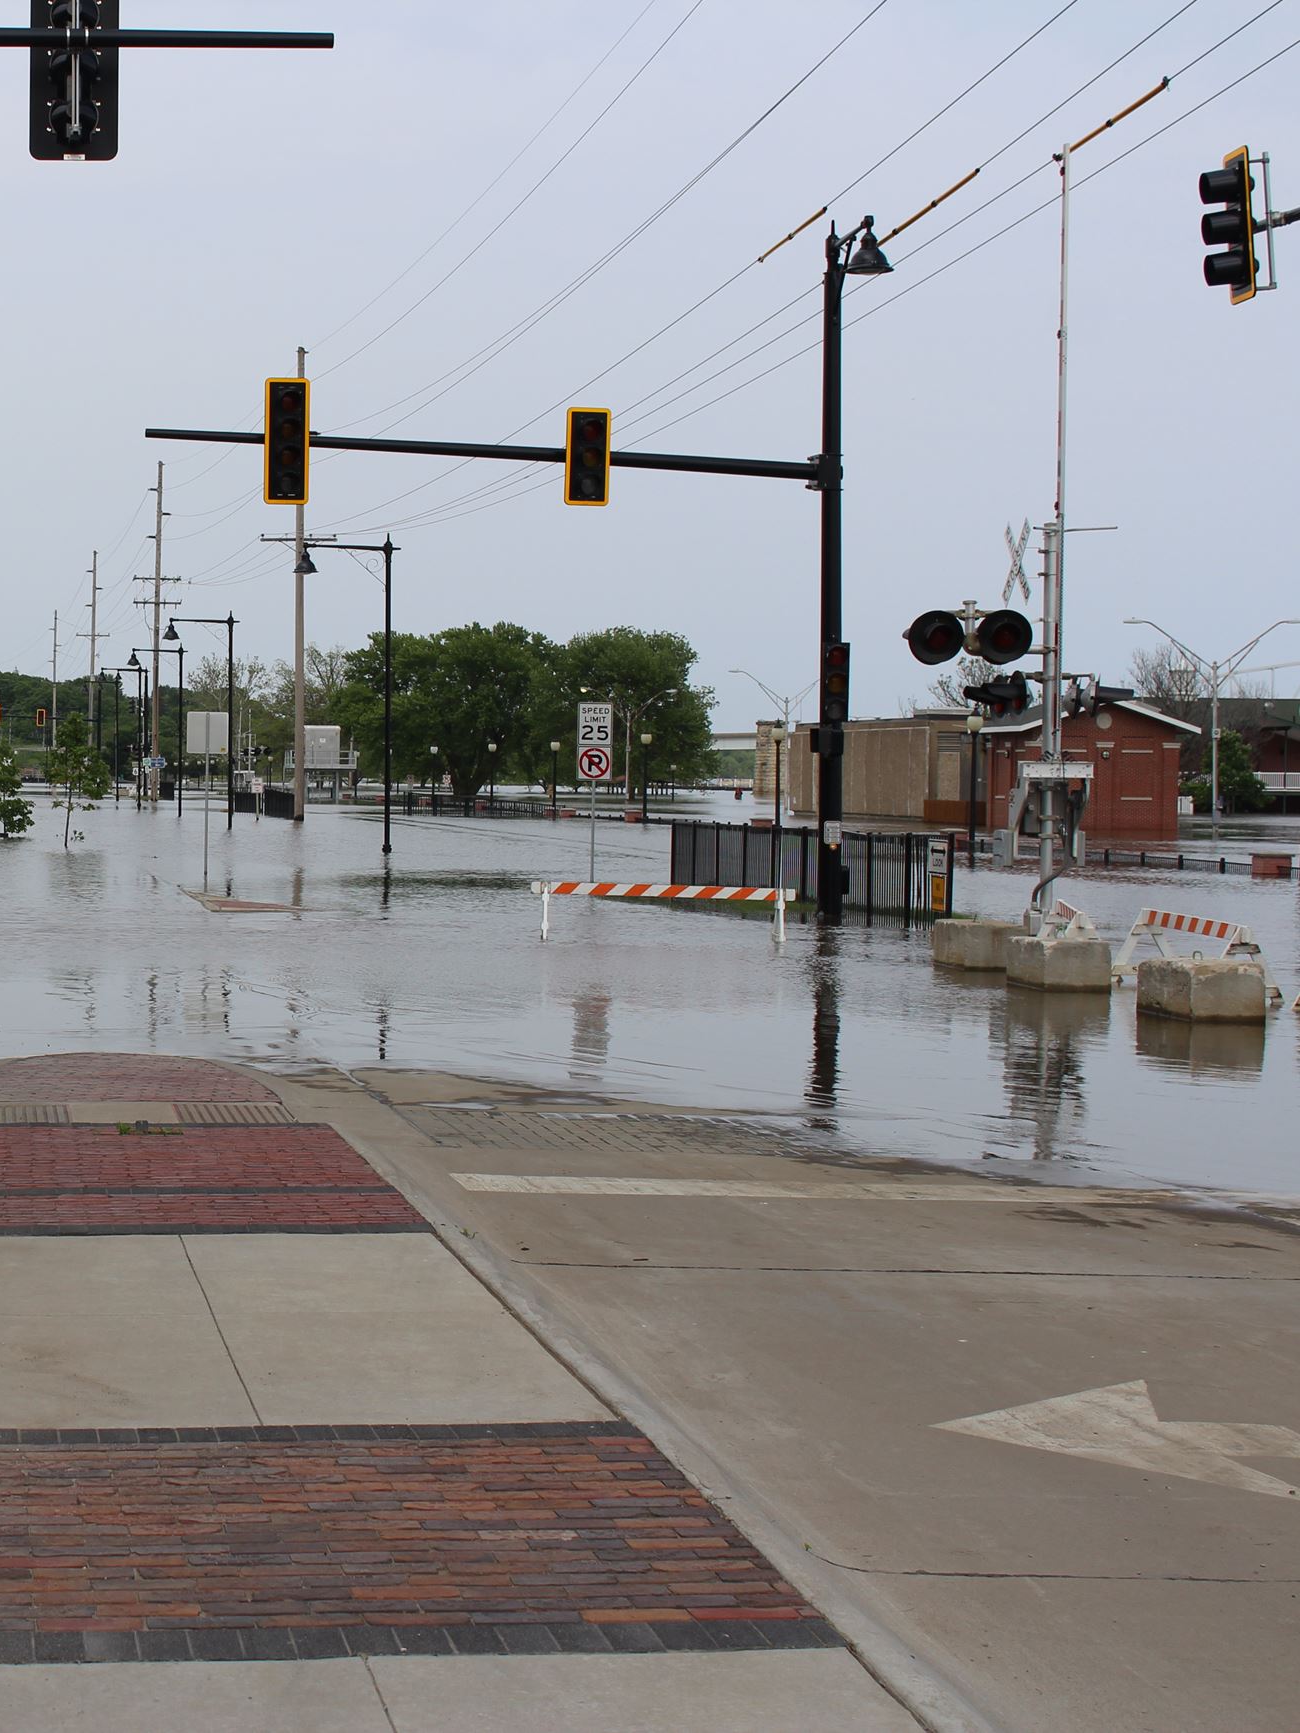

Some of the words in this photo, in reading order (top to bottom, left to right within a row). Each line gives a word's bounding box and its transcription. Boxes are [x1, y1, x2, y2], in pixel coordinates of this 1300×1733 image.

[1003, 518, 1030, 601] CROSSING
[582, 707, 610, 715] SPEED
[581, 725, 609, 741] 25
[933, 858, 943, 867] LOOK
